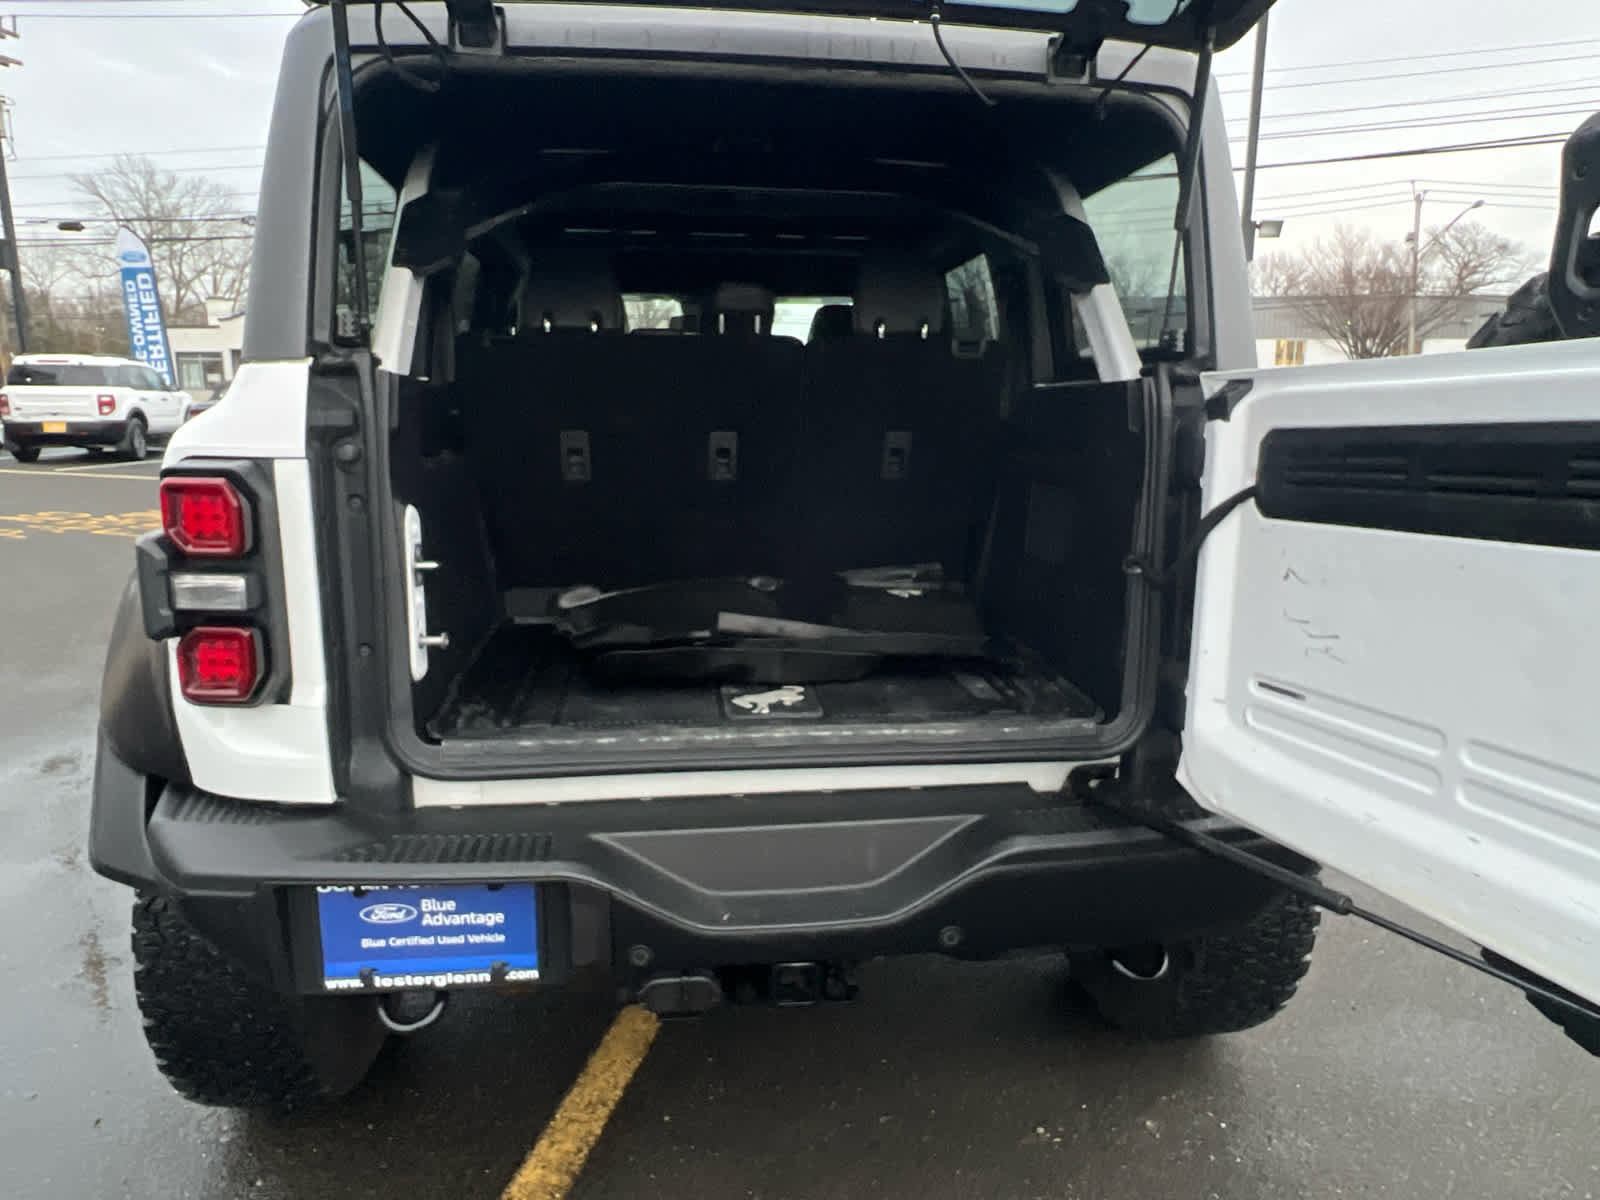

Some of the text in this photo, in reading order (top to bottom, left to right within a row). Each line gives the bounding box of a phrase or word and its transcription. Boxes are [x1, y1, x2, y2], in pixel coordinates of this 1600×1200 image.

[420, 898, 456, 912] Blue
[421, 911, 504, 927] Advantage
[361, 931, 506, 948] Blue Certified Used Vehicle
